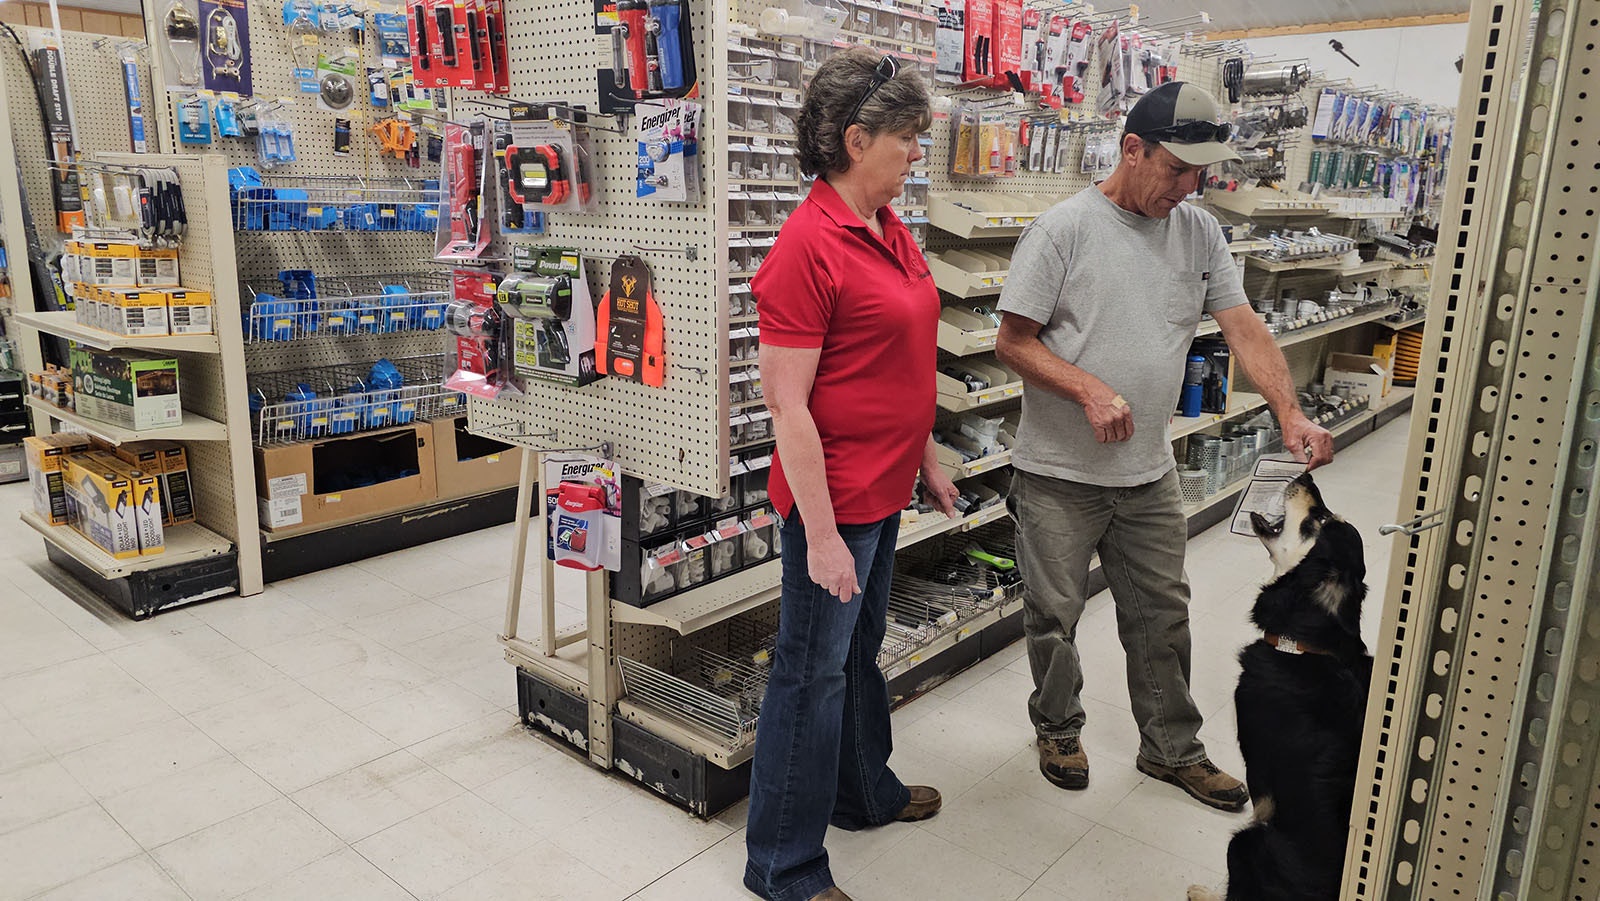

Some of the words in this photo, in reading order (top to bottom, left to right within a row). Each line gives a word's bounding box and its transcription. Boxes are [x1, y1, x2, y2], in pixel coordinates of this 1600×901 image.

[46, 50, 57, 78] DOUBLE
[50, 79, 61, 102] DRAFT
[54, 103, 63, 121] STOP
[641, 106, 681, 132] Energizer
[564, 499, 583, 508] Energizer
[118, 536, 126, 552] SOLAR
[122, 521, 131, 551] FLOODLIGHT
[148, 517, 156, 547] FLOODLIGHT
